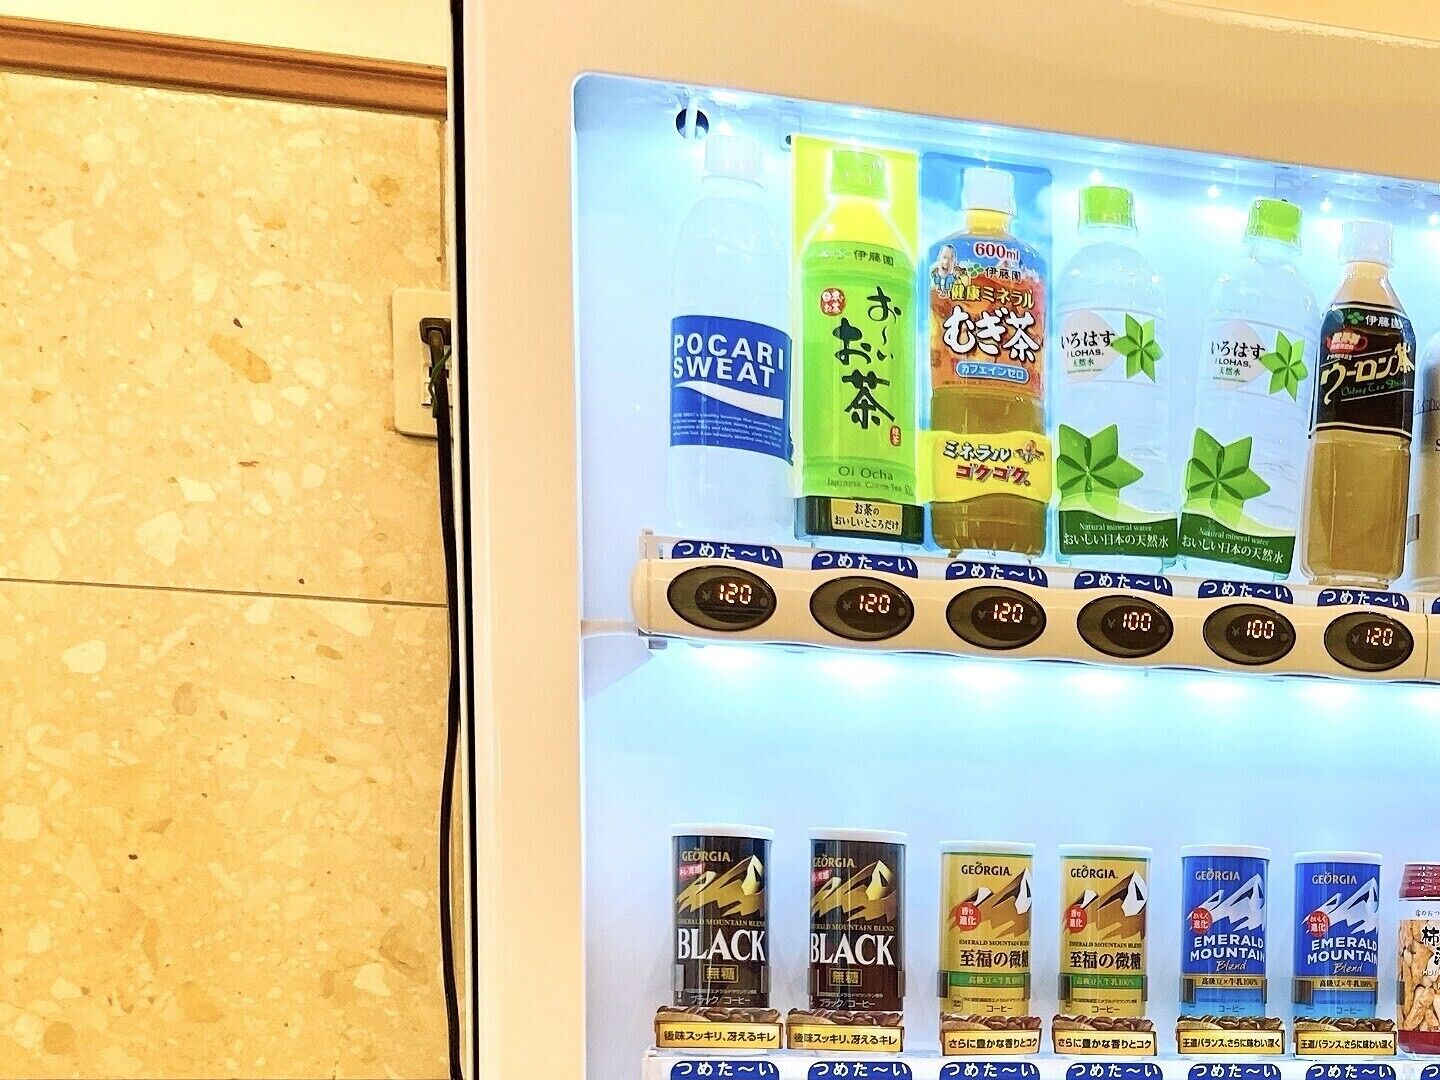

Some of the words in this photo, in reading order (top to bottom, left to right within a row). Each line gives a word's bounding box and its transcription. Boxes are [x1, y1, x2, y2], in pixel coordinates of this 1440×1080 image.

[974, 243, 1020, 261] 600ml
[951, 283, 1034, 309] 健康ミネラル
[943, 305, 1040, 362] むぎ茶
[1061, 330, 1115, 349] いろはす
[673, 332, 784, 371] POCARI
[1211, 340, 1266, 361] いろはす
[673, 356, 775, 388] SWEAT
[961, 364, 1024, 379] カフェインゼロ
[943, 439, 1012, 462] ミネラル
[861, 467, 894, 481] Ocha
[854, 502, 880, 516] お茶の
[834, 514, 900, 531] おいしいところだけ
[1063, 532, 1169, 549] おいしい日本の天然水
[1181, 535, 1284, 564] おいしい日本の天然水
[717, 583, 753, 605] 120
[858, 593, 891, 614] 120
[992, 602, 1024, 623] 120
[1121, 611, 1152, 632] 100
[1245, 620, 1275, 640] 100
[1365, 627, 1394, 647] 120
[961, 861, 1012, 876] GEORGIA
[1070, 865, 1117, 879] GEORGIA
[1195, 868, 1240, 881] GEORGIA
[1312, 872, 1358, 885] GEORGIA
[677, 928, 766, 960] BLACK
[810, 932, 895, 965] BLACK
[1194, 934, 1264, 949] EMERALD
[1311, 936, 1377, 951] EMERALD
[1070, 951, 1141, 969] 至福の微糖
[1190, 947, 1265, 962] MOUNTAIN
[1215, 959, 1248, 972] Blend
[1333, 962, 1363, 975] Blend
[664, 1030, 776, 1043] 後味スッキリ、冴えるキレ
[794, 1032, 897, 1045] 後味スッキリ、冴えるキレ
[948, 1037, 1038, 1050] さらに豊かな香りとコク
[1058, 1037, 1152, 1050] さらに豊かな香りとコク
[1183, 1038, 1280, 1050] 王道バランス、さらに味わい深く
[1300, 1039, 1394, 1051] 王道バランス、さらに味わい深く
